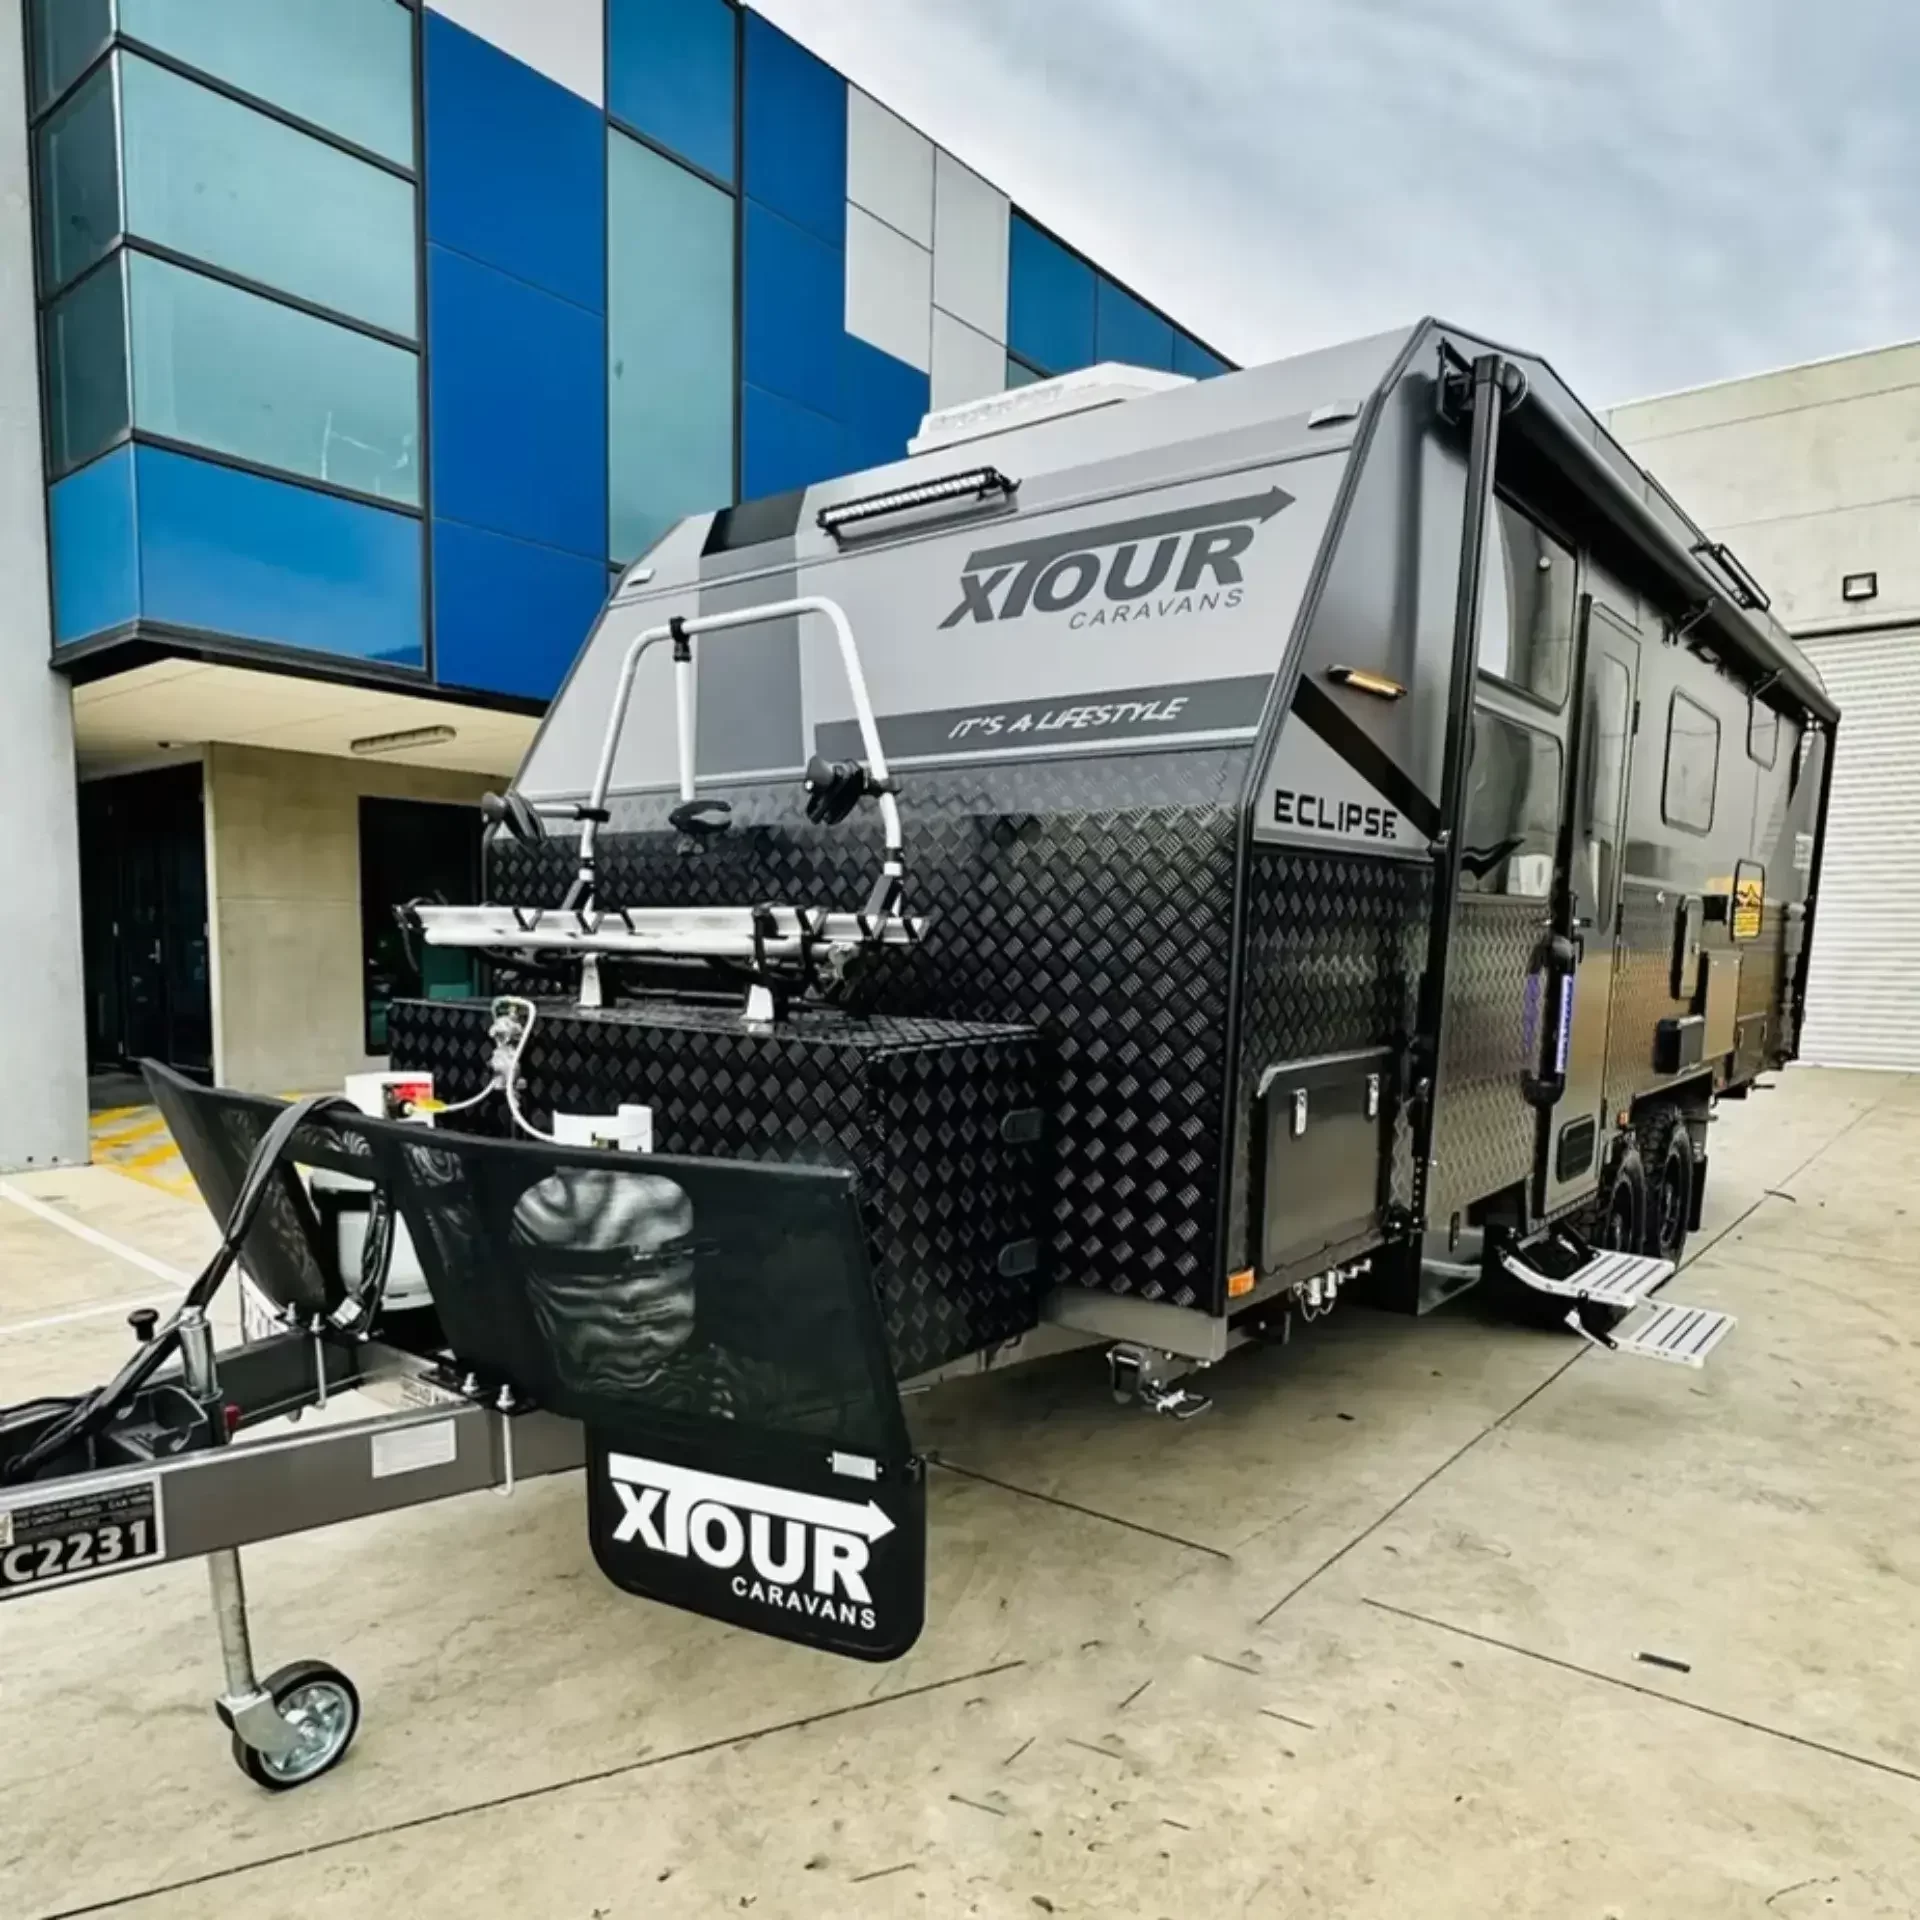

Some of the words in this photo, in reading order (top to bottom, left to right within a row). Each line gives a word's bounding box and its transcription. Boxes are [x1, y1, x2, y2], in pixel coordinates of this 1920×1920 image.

[937, 500, 1258, 630] XTOUR
[1069, 588, 1245, 630] CARAVANS
[948, 715, 1006, 739] IT'S
[1007, 713, 1033, 733] A
[1035, 697, 1189, 731] LIFESTYLE
[1274, 788, 1398, 839] ECLIPSE
[0, 1520, 147, 1582] C2231
[608, 1456, 876, 1604] XTOUR
[731, 1576, 877, 1630] CARAVANS
